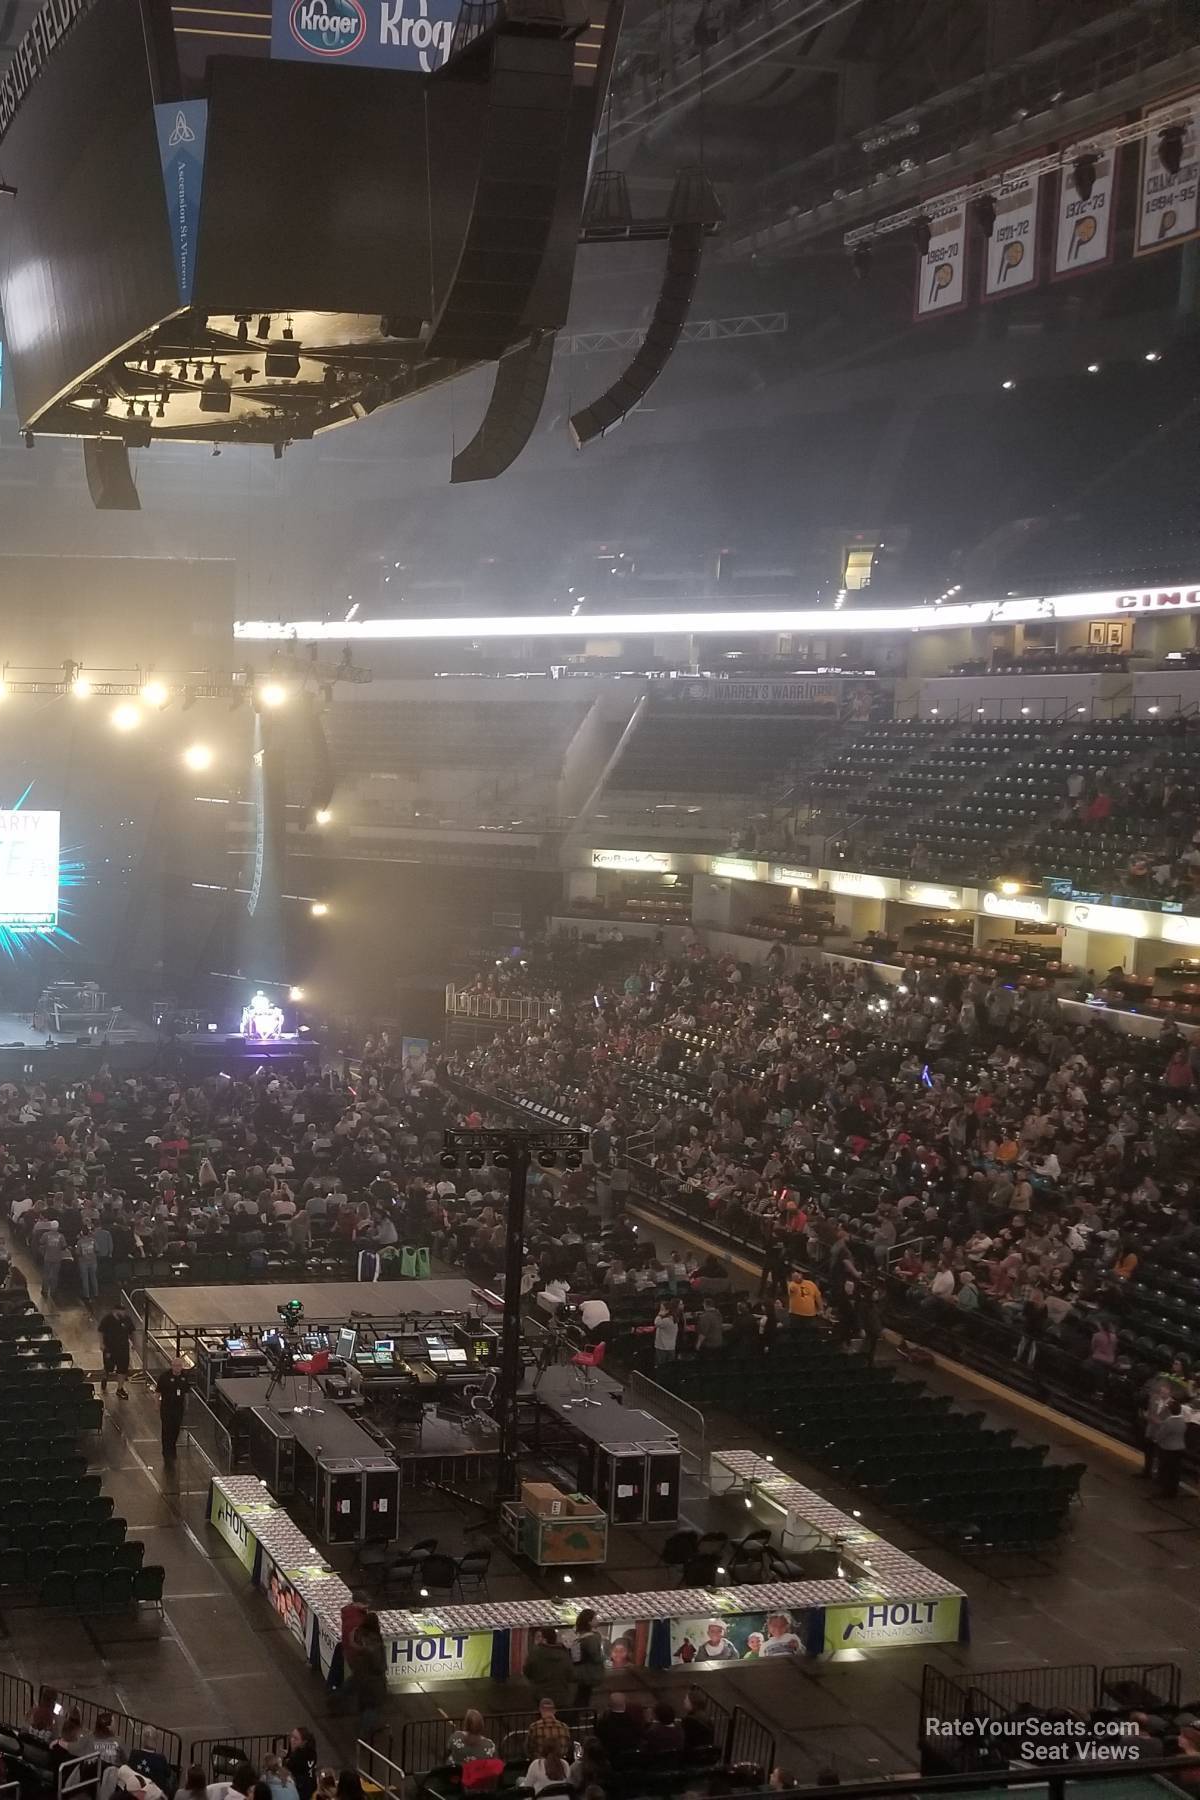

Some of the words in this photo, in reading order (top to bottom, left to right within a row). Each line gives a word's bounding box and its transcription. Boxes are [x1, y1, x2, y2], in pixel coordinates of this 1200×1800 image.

[301, 3, 358, 45] Kroger
[10, 30, 37, 100] LIFE
[177, 161, 188, 224] Ascension
[1066, 193, 1106, 219] 1972-73
[997, 220, 1030, 242] 1971-72
[714, 683, 769, 700] WARREN'S
[224, 1502, 250, 1548] HOLT
[868, 1602, 938, 1628] HOLT
[391, 1635, 469, 1664] HOLT
[386, 1661, 465, 1677] TERNATIONAL
